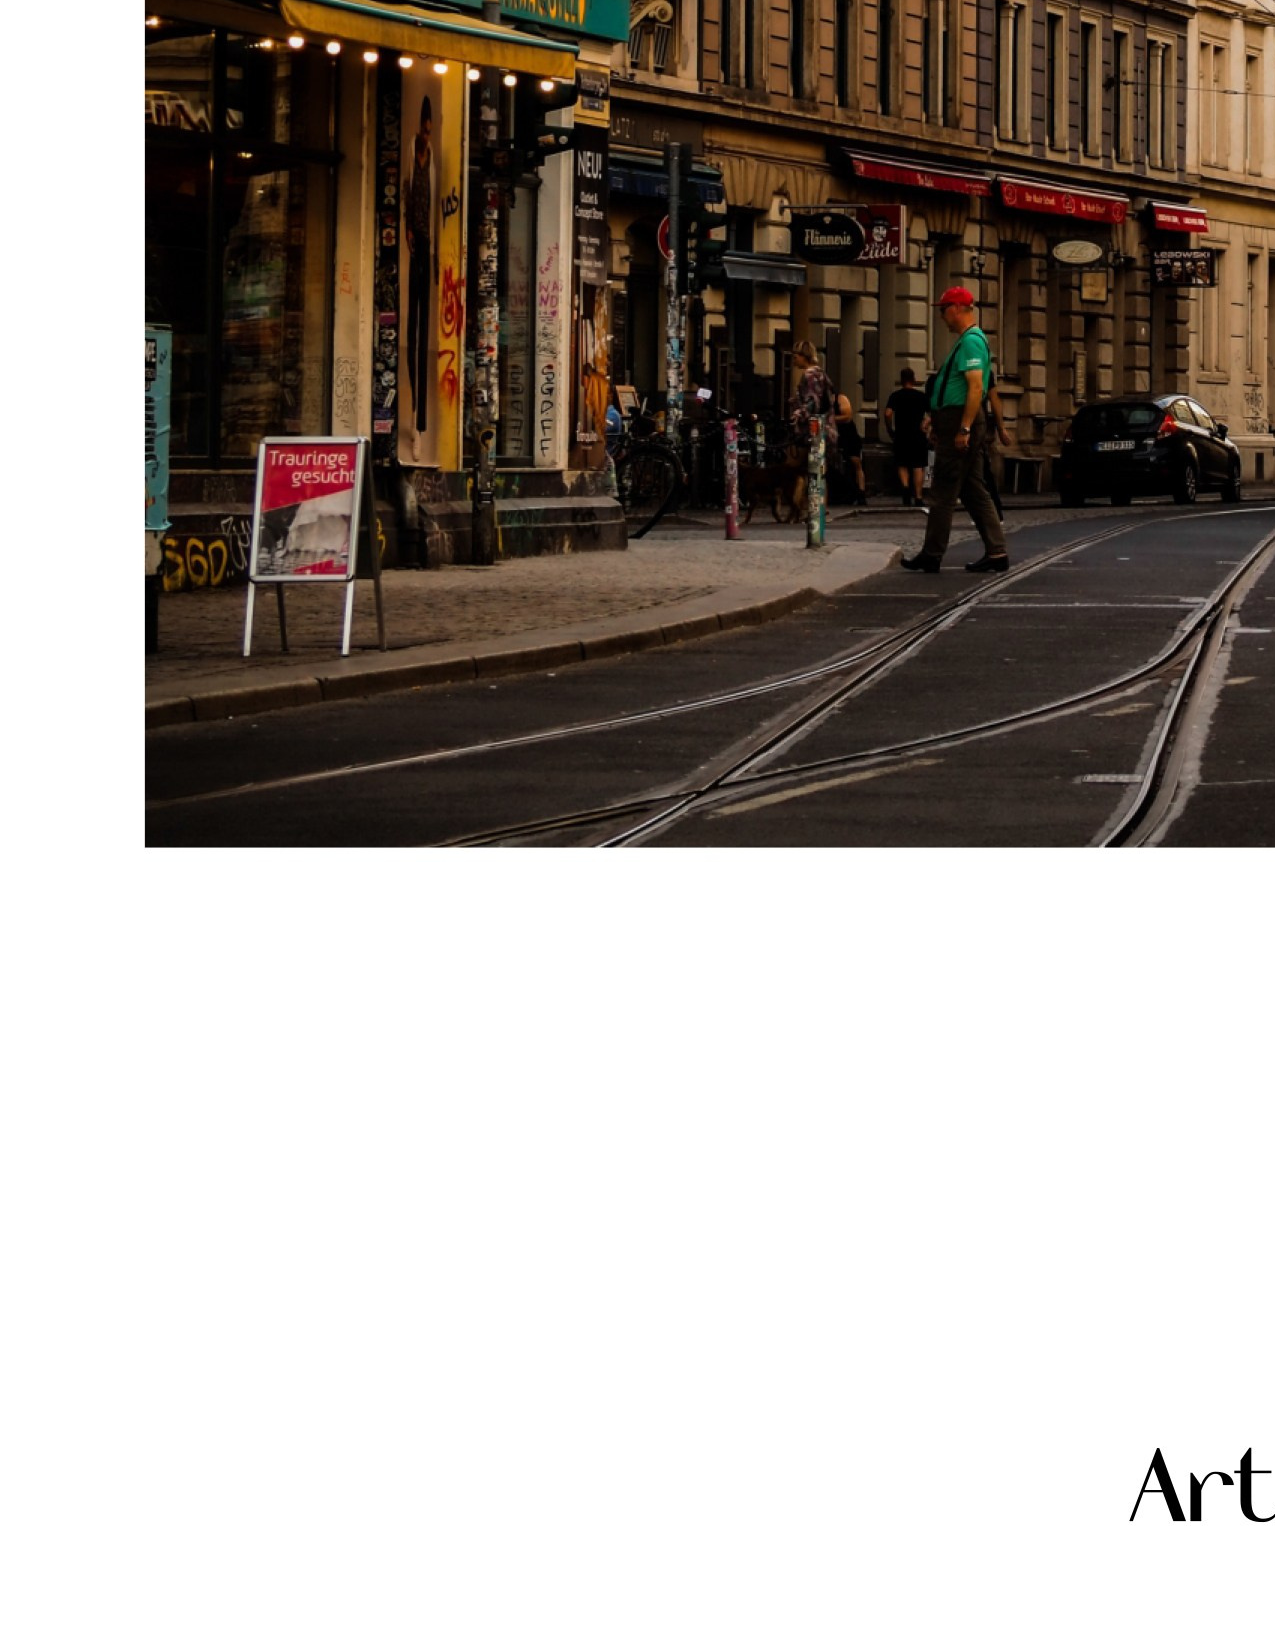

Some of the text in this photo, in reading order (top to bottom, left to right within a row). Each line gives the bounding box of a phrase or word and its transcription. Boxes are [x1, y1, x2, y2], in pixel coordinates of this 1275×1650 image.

[577, 150, 603, 180] NEU!
[269, 450, 347, 469] Trauringe
[291, 469, 356, 487] gesucht
